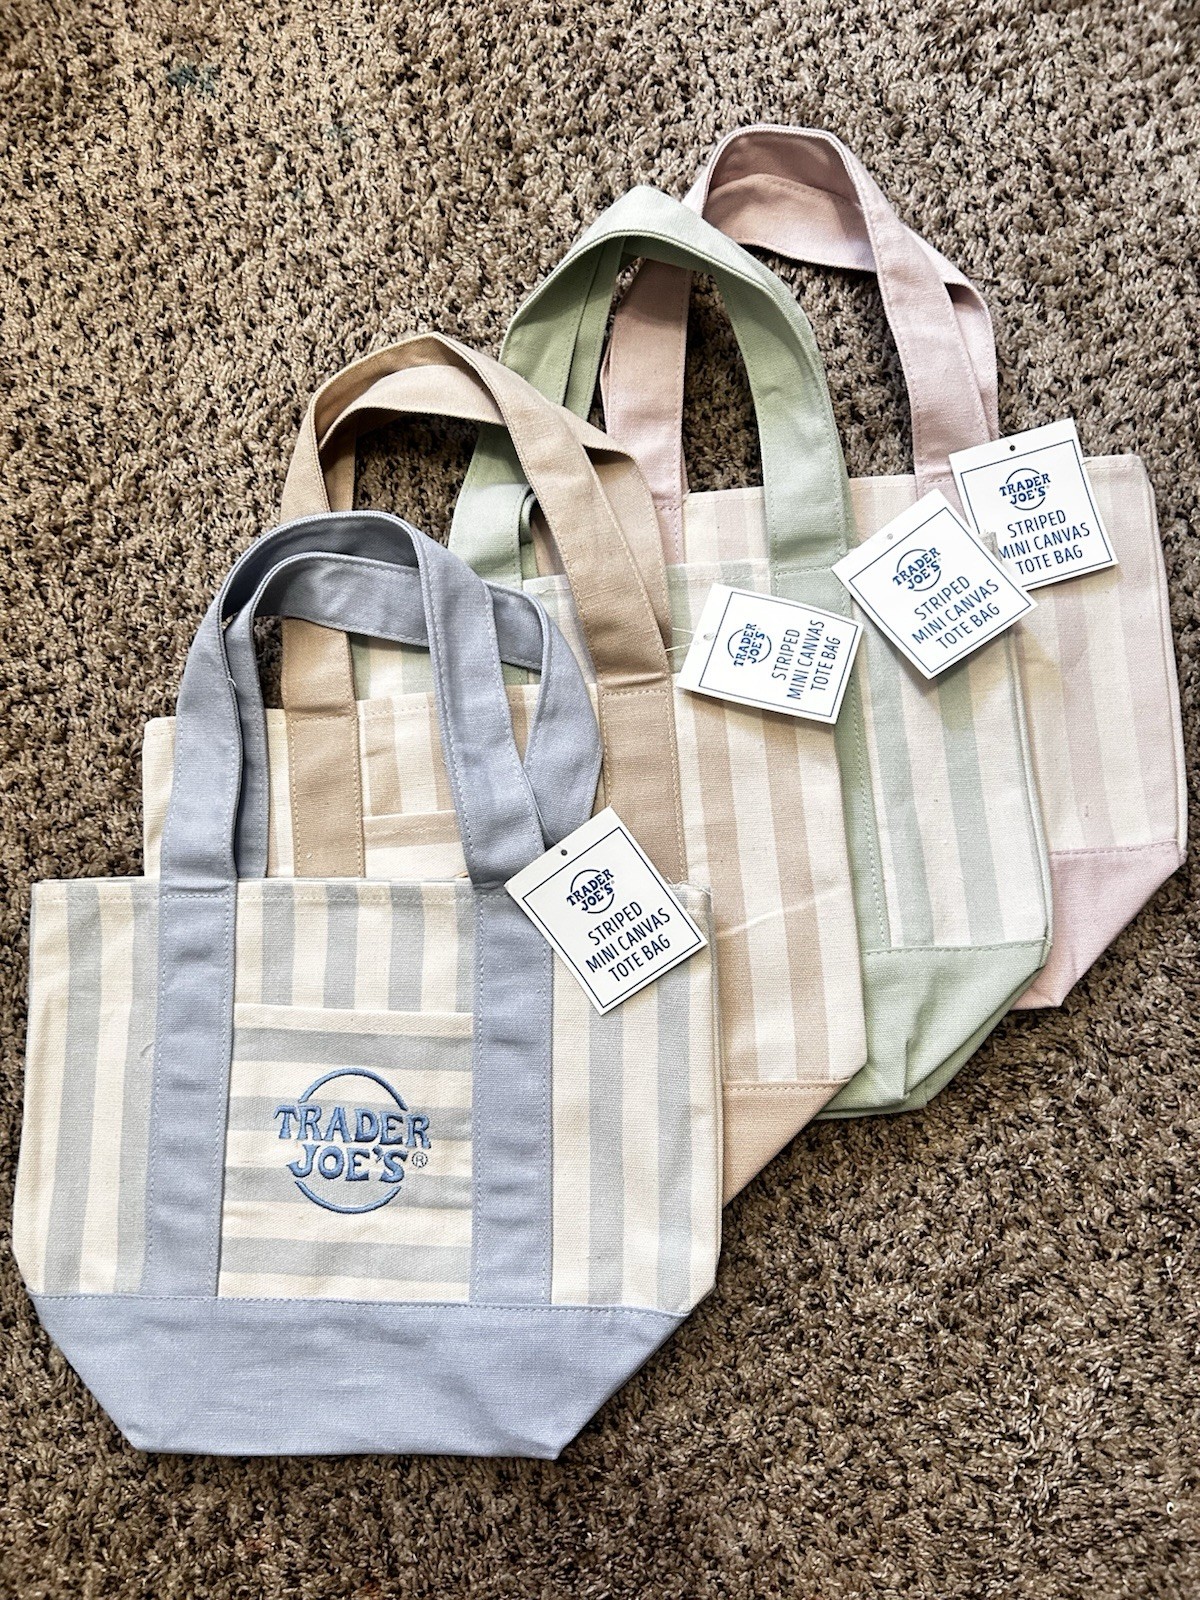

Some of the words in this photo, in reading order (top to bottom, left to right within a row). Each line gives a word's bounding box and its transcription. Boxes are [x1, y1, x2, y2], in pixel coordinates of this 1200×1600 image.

[999, 473, 1051, 496] TRADER
[1001, 540, 1031, 559] MINI
[1034, 523, 1090, 550] CANVAS
[1007, 510, 1066, 538] STRIPED
[892, 547, 941, 586] TRADER
[1015, 554, 1052, 574] TOTE
[1054, 545, 1083, 564] BAG
[912, 617, 947, 644] MINI
[945, 579, 999, 621] CANVAS
[914, 576, 970, 620] STRIPED
[734, 623, 757, 667] TRADER
[936, 622, 972, 649] TOTE
[972, 603, 1000, 627] BAG
[772, 629, 800, 680] STRIPED
[787, 670, 809, 700] MINI
[798, 620, 825, 666] CANVAS
[821, 637, 840, 660] BAG
[811, 662, 833, 690] TOTE
[566, 869, 614, 906] TRADER
[586, 944, 620, 973] MINI
[617, 908, 671, 950] CANVAS
[588, 901, 643, 945] STRIPED
[608, 952, 643, 982] TOTE
[641, 934, 671, 961] BAG
[274, 1105, 431, 1149] TRADER
